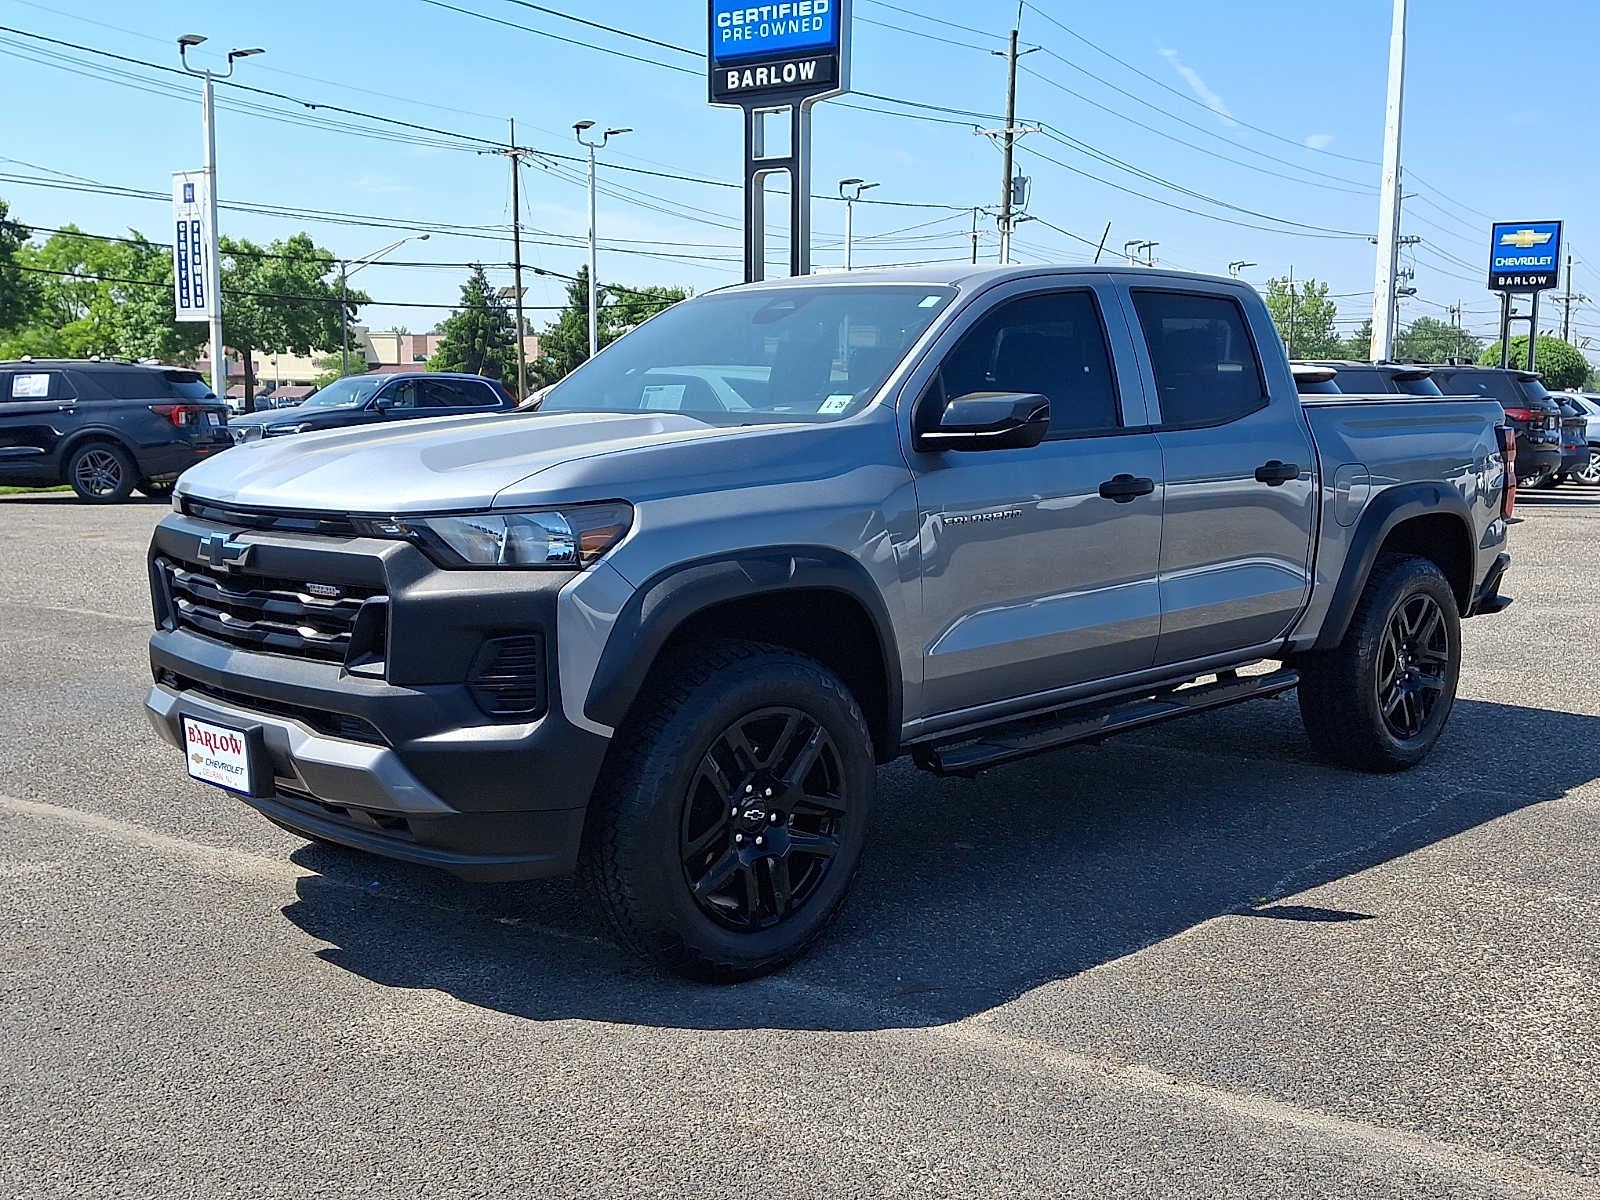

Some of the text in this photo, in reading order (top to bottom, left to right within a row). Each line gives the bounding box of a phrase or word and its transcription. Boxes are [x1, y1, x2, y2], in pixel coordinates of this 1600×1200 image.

[717, 0, 829, 28] CERTIFIED
[722, 16, 823, 43] PRE-OWNED
[727, 61, 816, 90] BARLOW
[178, 222, 189, 307] CERTIFIED
[1495, 256, 1553, 267] CHEVROLET
[1498, 276, 1547, 286] BARLOW
[188, 726, 243, 756] BARLOW
[205, 758, 245, 776] CHEVROLET
